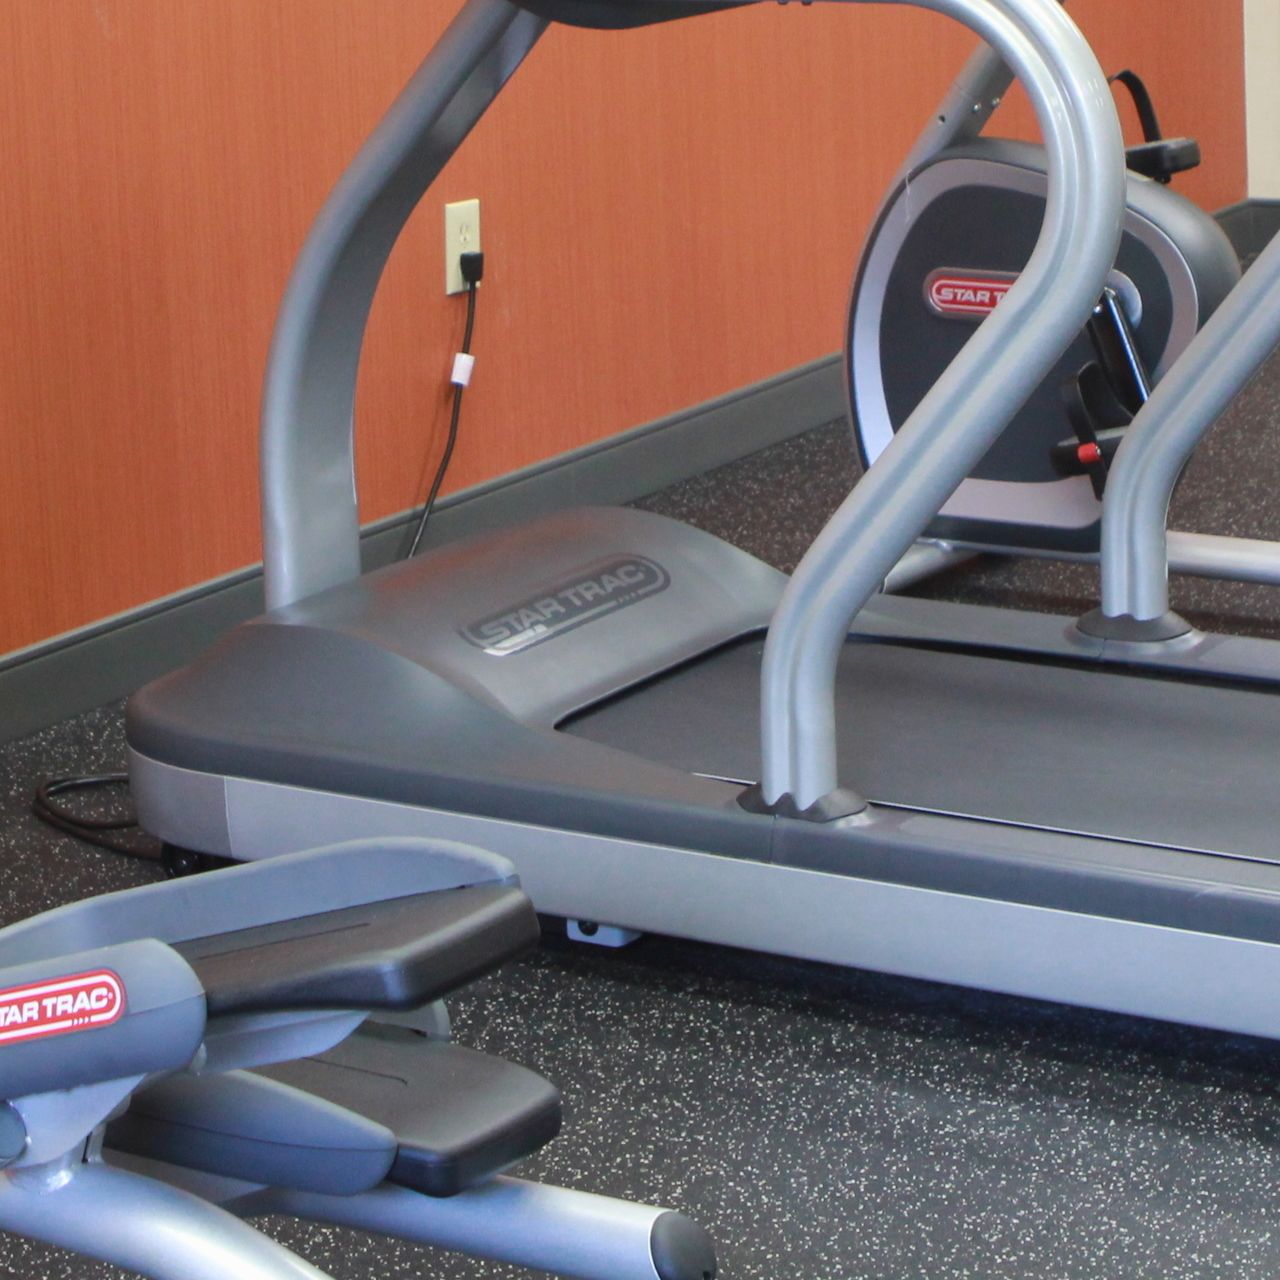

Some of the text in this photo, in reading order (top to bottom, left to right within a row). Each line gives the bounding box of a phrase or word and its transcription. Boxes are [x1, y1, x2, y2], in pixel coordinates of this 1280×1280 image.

[938, 287, 991, 303] STAR
[477, 565, 645, 643] STAR TRAC
[41, 987, 109, 1018] TRAC
